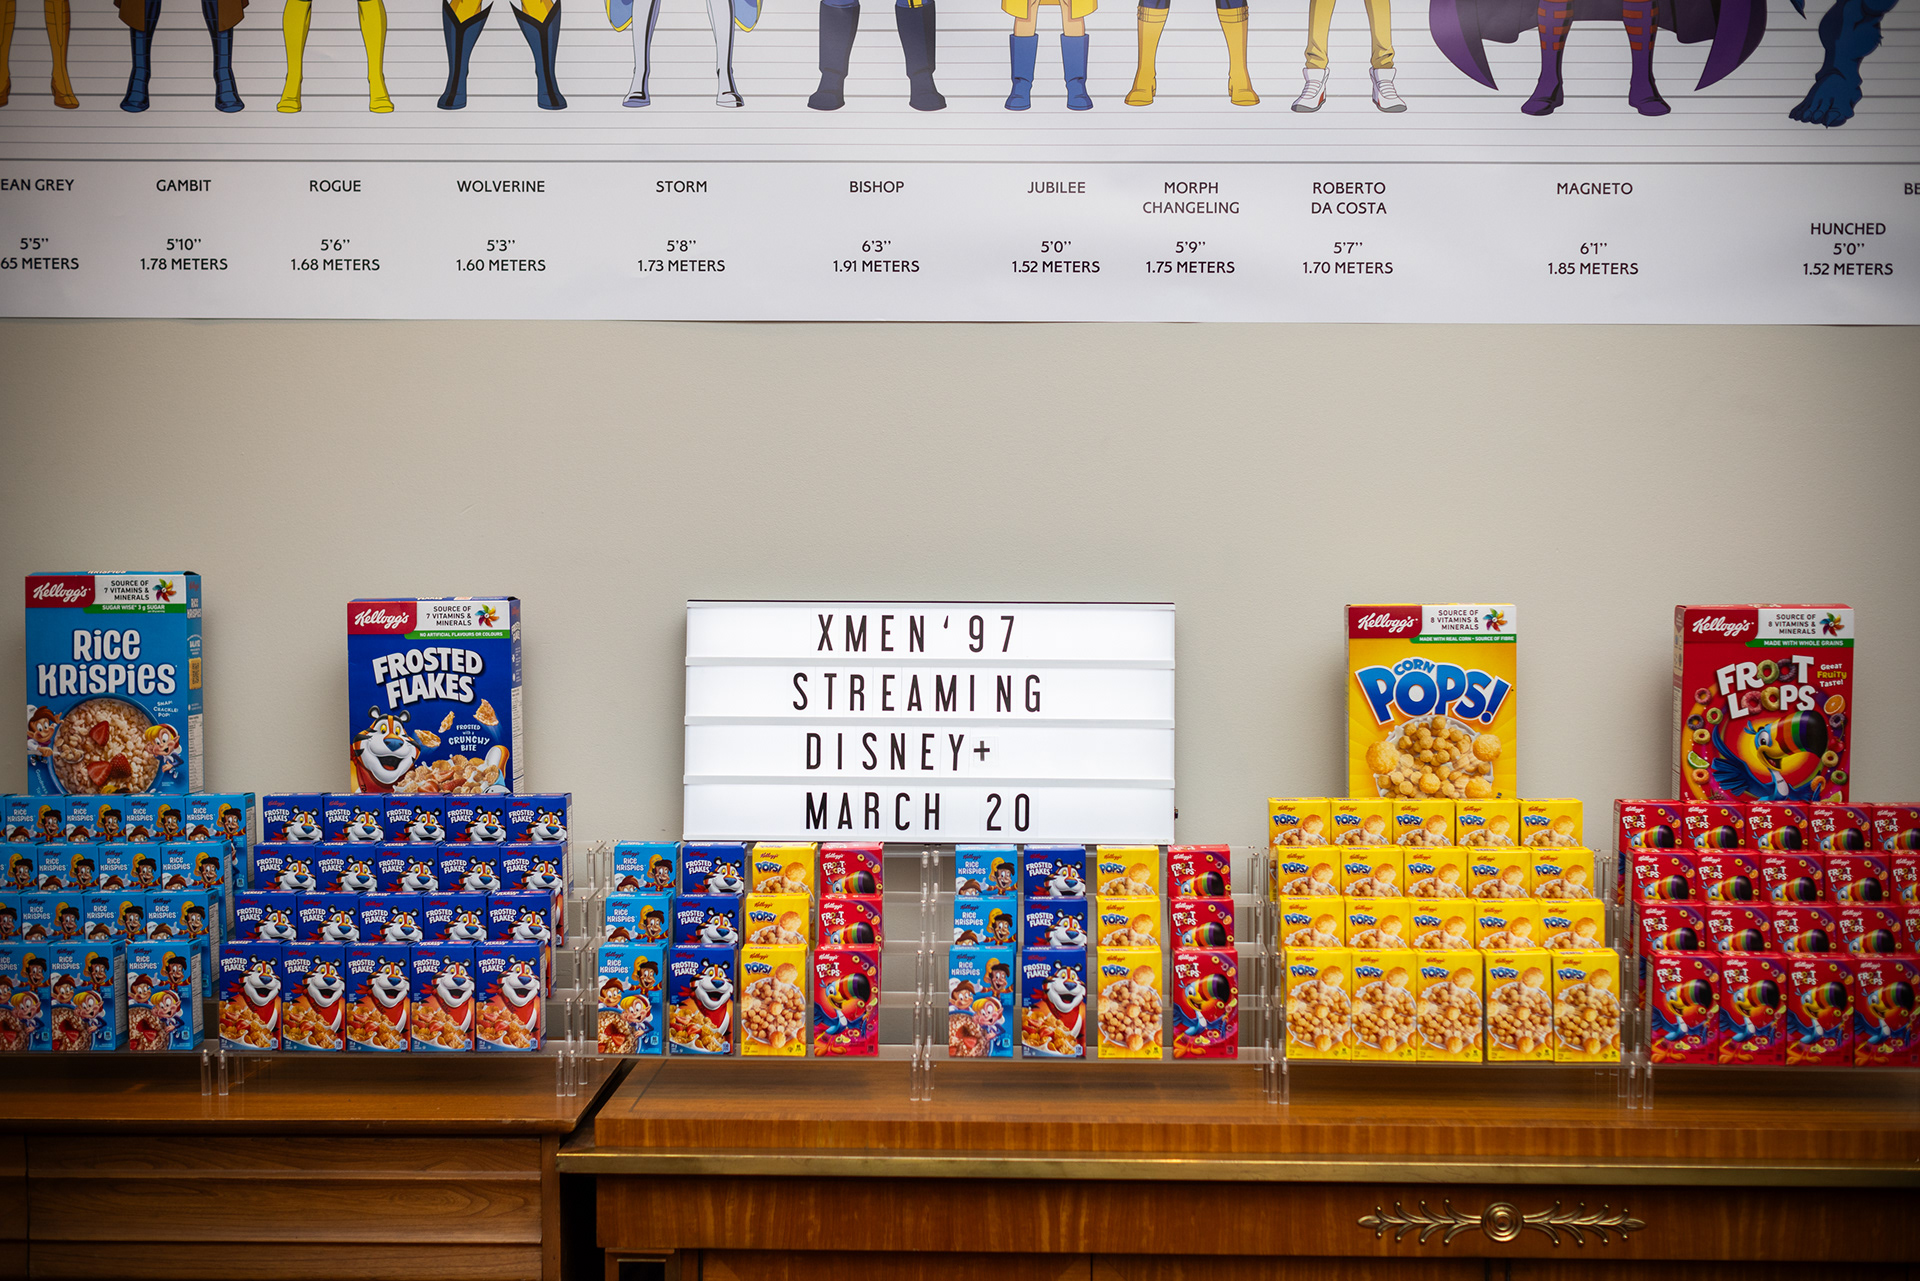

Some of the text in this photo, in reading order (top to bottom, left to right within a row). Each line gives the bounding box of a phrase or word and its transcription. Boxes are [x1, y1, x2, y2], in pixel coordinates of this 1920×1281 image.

[34, 179, 75, 191] GREY
[155, 178, 212, 192] GAMBIT
[309, 179, 362, 193] ROGUE
[456, 179, 545, 193] WOLVERINE
[655, 180, 708, 193] STORM
[849, 180, 905, 194] BISHOP
[1027, 181, 1086, 194] JUBILEE
[1164, 181, 1219, 195] MORPH
[1312, 181, 1386, 195] ROBERTO
[1556, 182, 1634, 195] MAGNETO
[1142, 201, 1240, 214] CHANGELING
[1311, 201, 1387, 215] DA COSTA
[1810, 222, 1887, 236] HUNCHED
[21, 257, 80, 270] METERS
[140, 257, 228, 271] 1.78 METERS
[290, 258, 381, 271] 1.68 METERS
[456, 258, 547, 272] 1.60 METERS
[637, 259, 726, 272] 1.73 METERS
[832, 259, 920, 273] 1.91 METERS
[1011, 260, 1101, 274] 1.52 METERS
[1145, 260, 1236, 274] 1.75 METERS
[1302, 261, 1394, 275] 1.70 METERS
[1547, 262, 1639, 275] 1.85 METERS
[1803, 262, 1894, 276] 1.52 METERS
[33, 582, 88, 602] Kellogg's
[354, 608, 410, 629] Kellogg's
[1357, 612, 1415, 633] Kellogg's
[1692, 616, 1751, 636] Kellogg's
[372, 647, 483, 684] FROSTED
[1394, 658, 1435, 676] CORN
[1716, 655, 1815, 696] FROOT
[386, 673, 475, 709] FLAKES
[792, 672, 1041, 713] STREAMING
[1356, 664, 1511, 723] POPS!
[1727, 684, 1816, 719] LOOPS
[448, 735, 490, 745] CRUNCHY
[806, 732, 991, 771] DISNEY+
[806, 792, 1030, 832] MARCH 20
